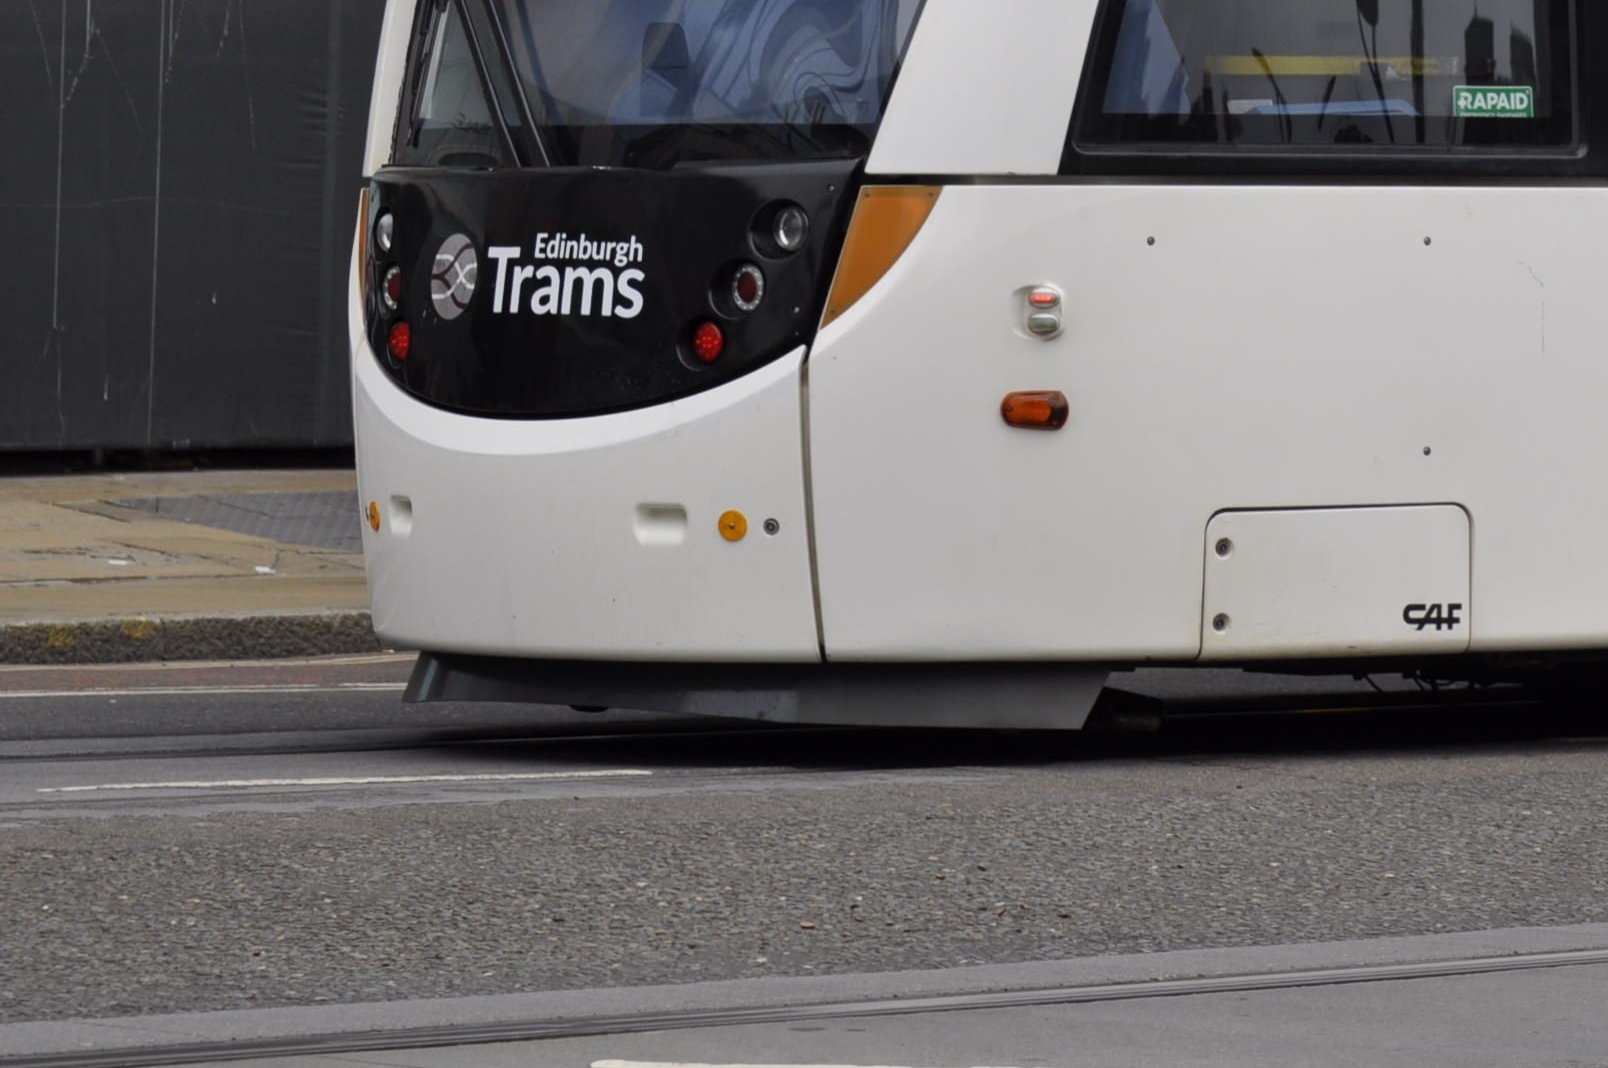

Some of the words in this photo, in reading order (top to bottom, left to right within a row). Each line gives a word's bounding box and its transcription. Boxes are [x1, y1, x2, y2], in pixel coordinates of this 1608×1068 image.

[1458, 92, 1529, 110] RAPAID
[534, 232, 644, 267] Edinburgh
[487, 245, 646, 319] Trams
[1402, 603, 1462, 631] CAF
